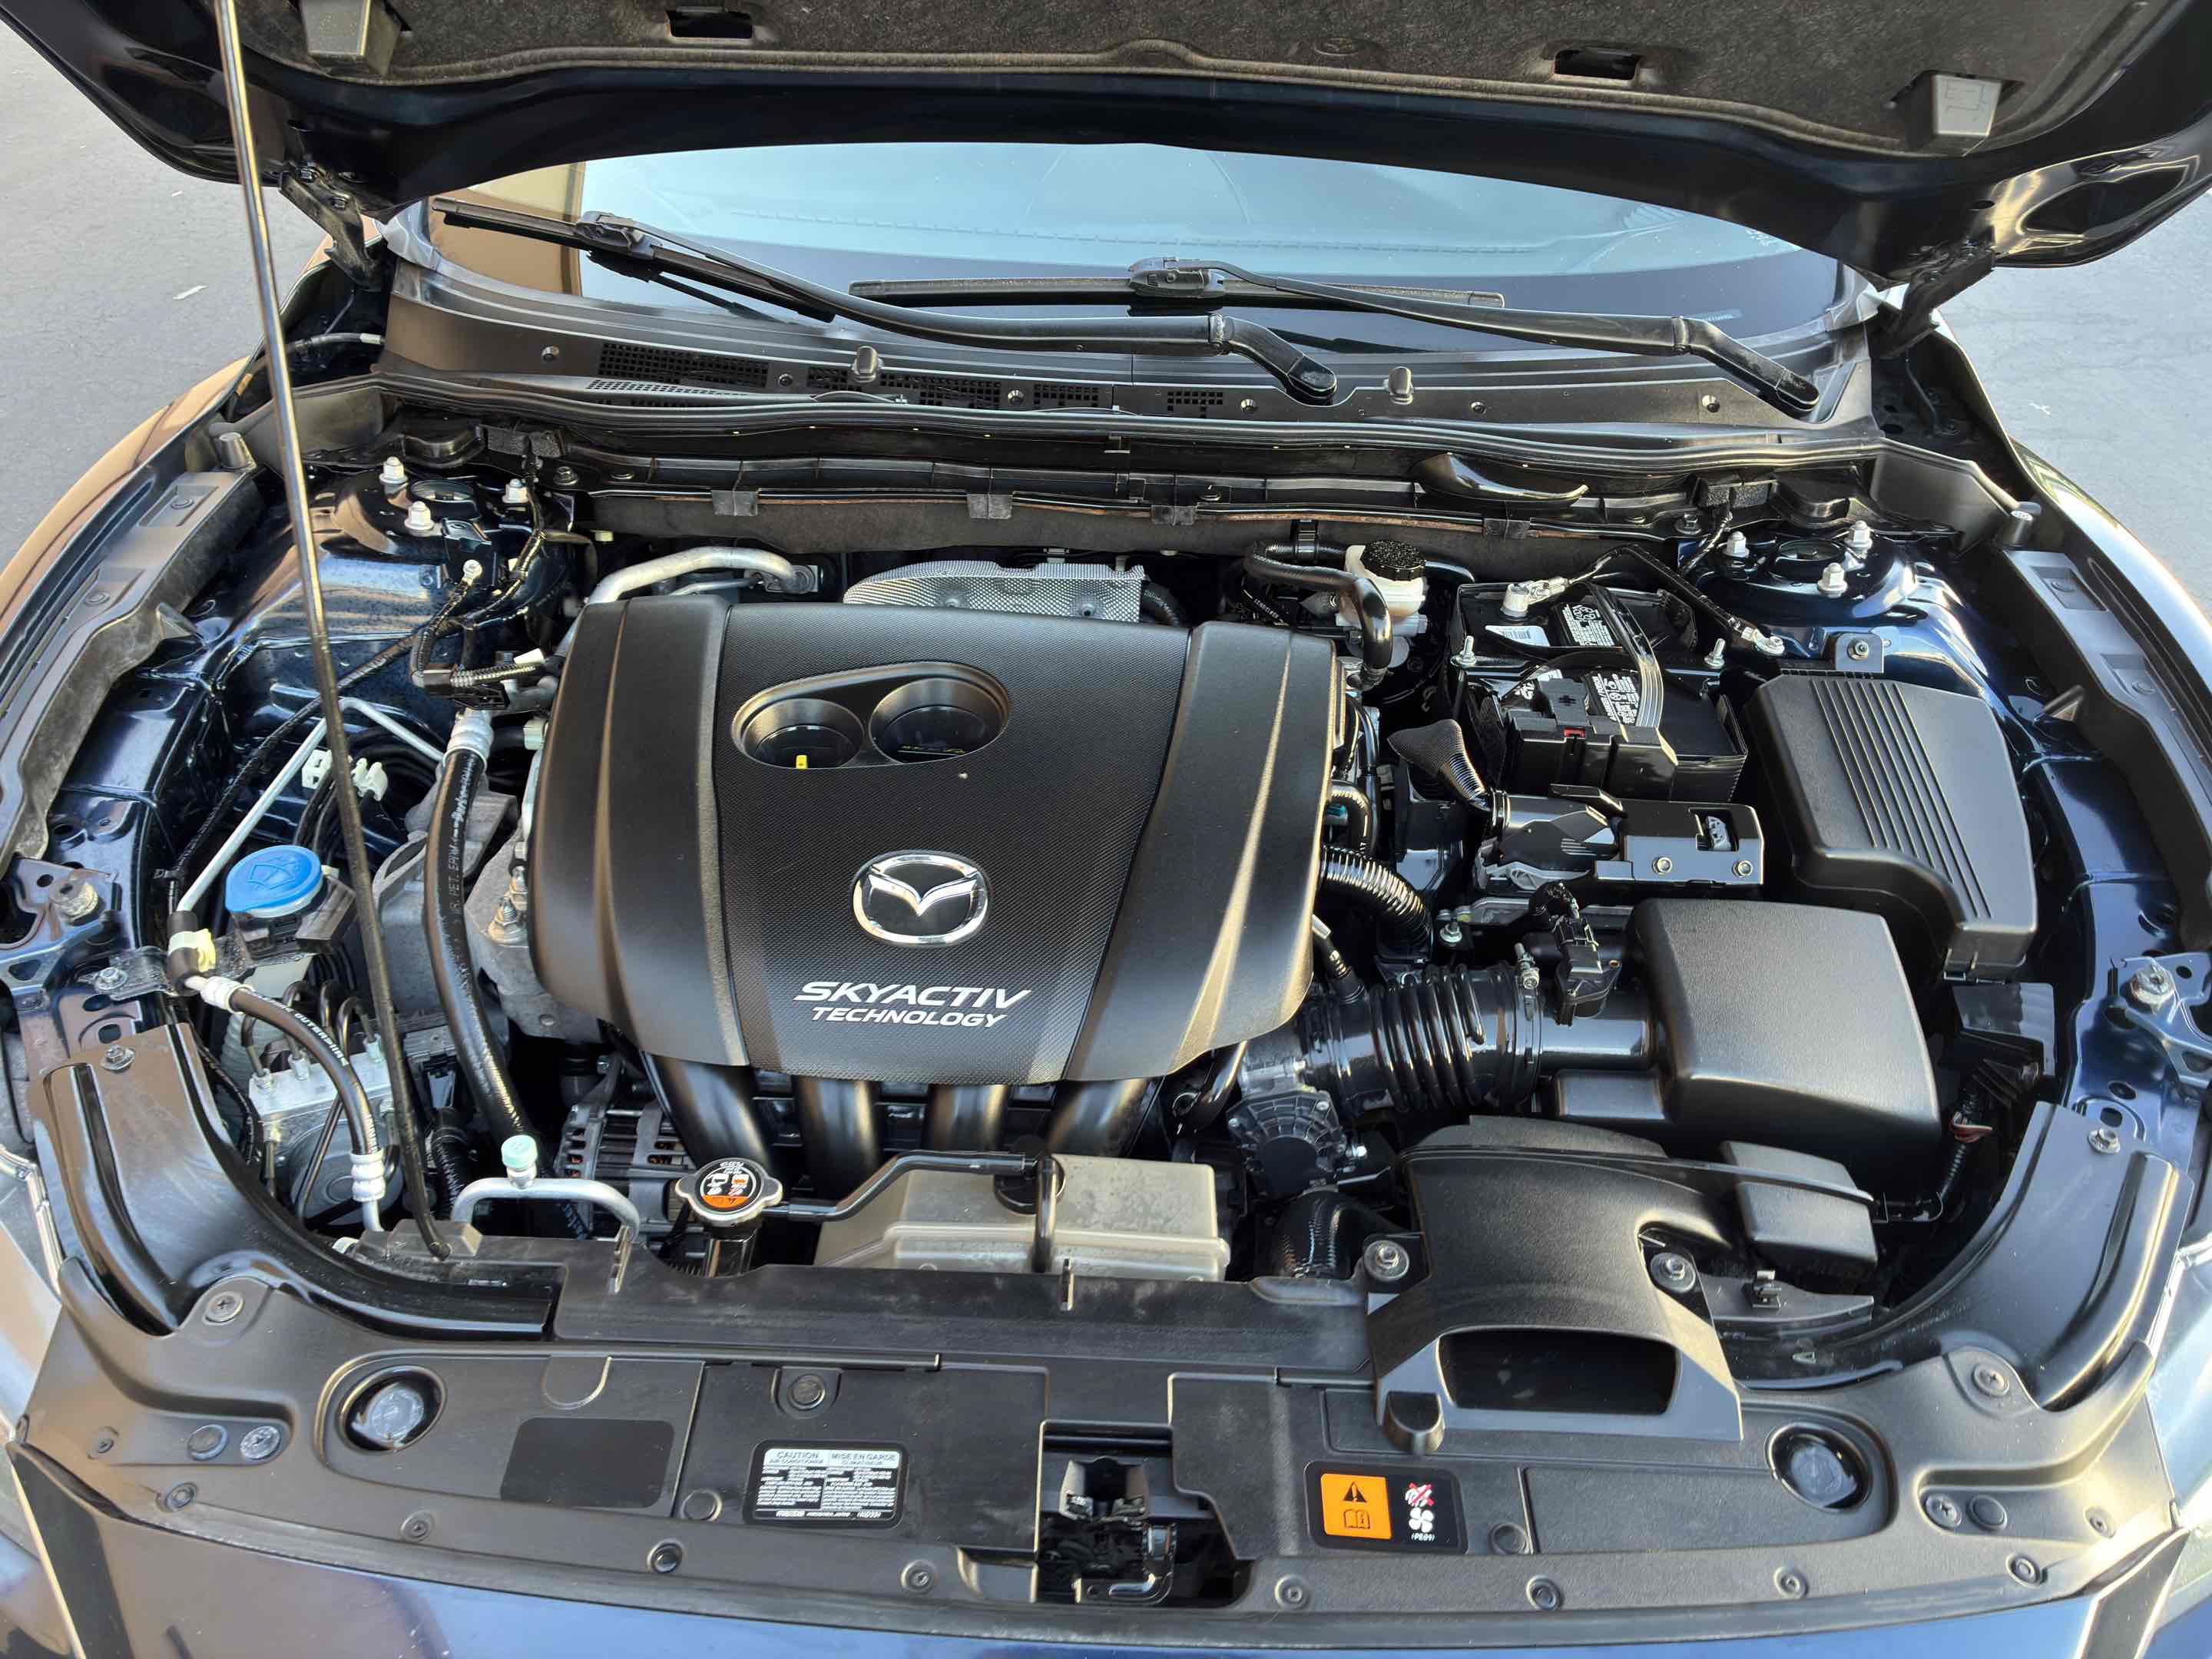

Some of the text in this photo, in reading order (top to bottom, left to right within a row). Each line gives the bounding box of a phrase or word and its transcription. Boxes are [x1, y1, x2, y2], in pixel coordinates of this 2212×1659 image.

[793, 982, 1031, 1008] SKYACTIV
[812, 1007, 1008, 1028] TECHNOLOGY
[777, 1451, 820, 1459] CAUTION
